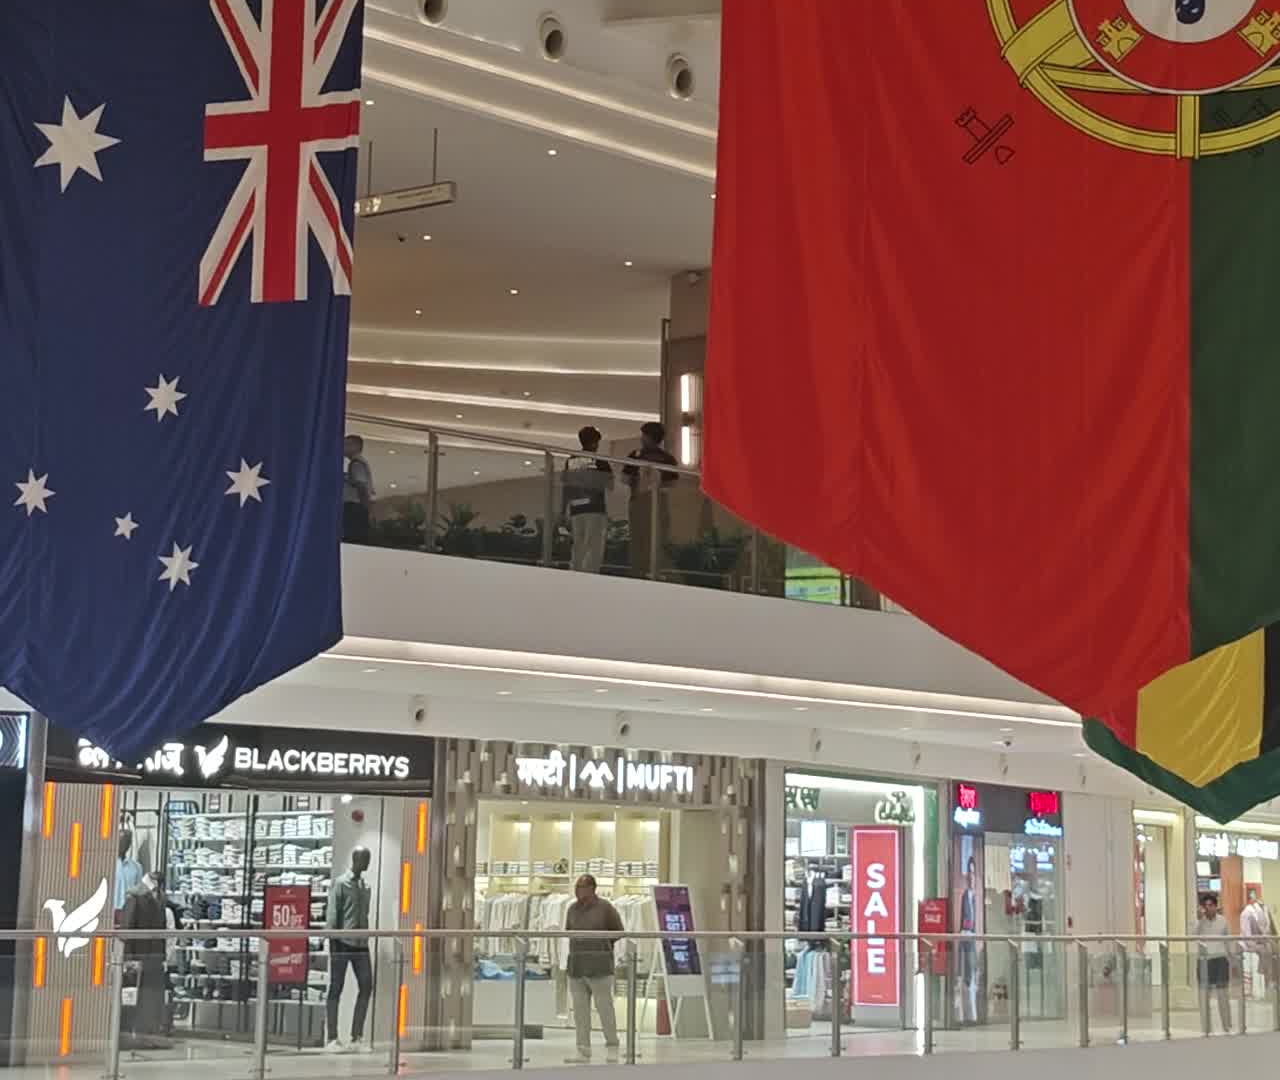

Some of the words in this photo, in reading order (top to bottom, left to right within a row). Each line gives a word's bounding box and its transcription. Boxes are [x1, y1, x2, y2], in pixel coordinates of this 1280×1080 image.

[233, 746, 410, 778] BLACKBERRYS
[626, 763, 693, 793] MUFTI
[863, 863, 888, 974] SALE
